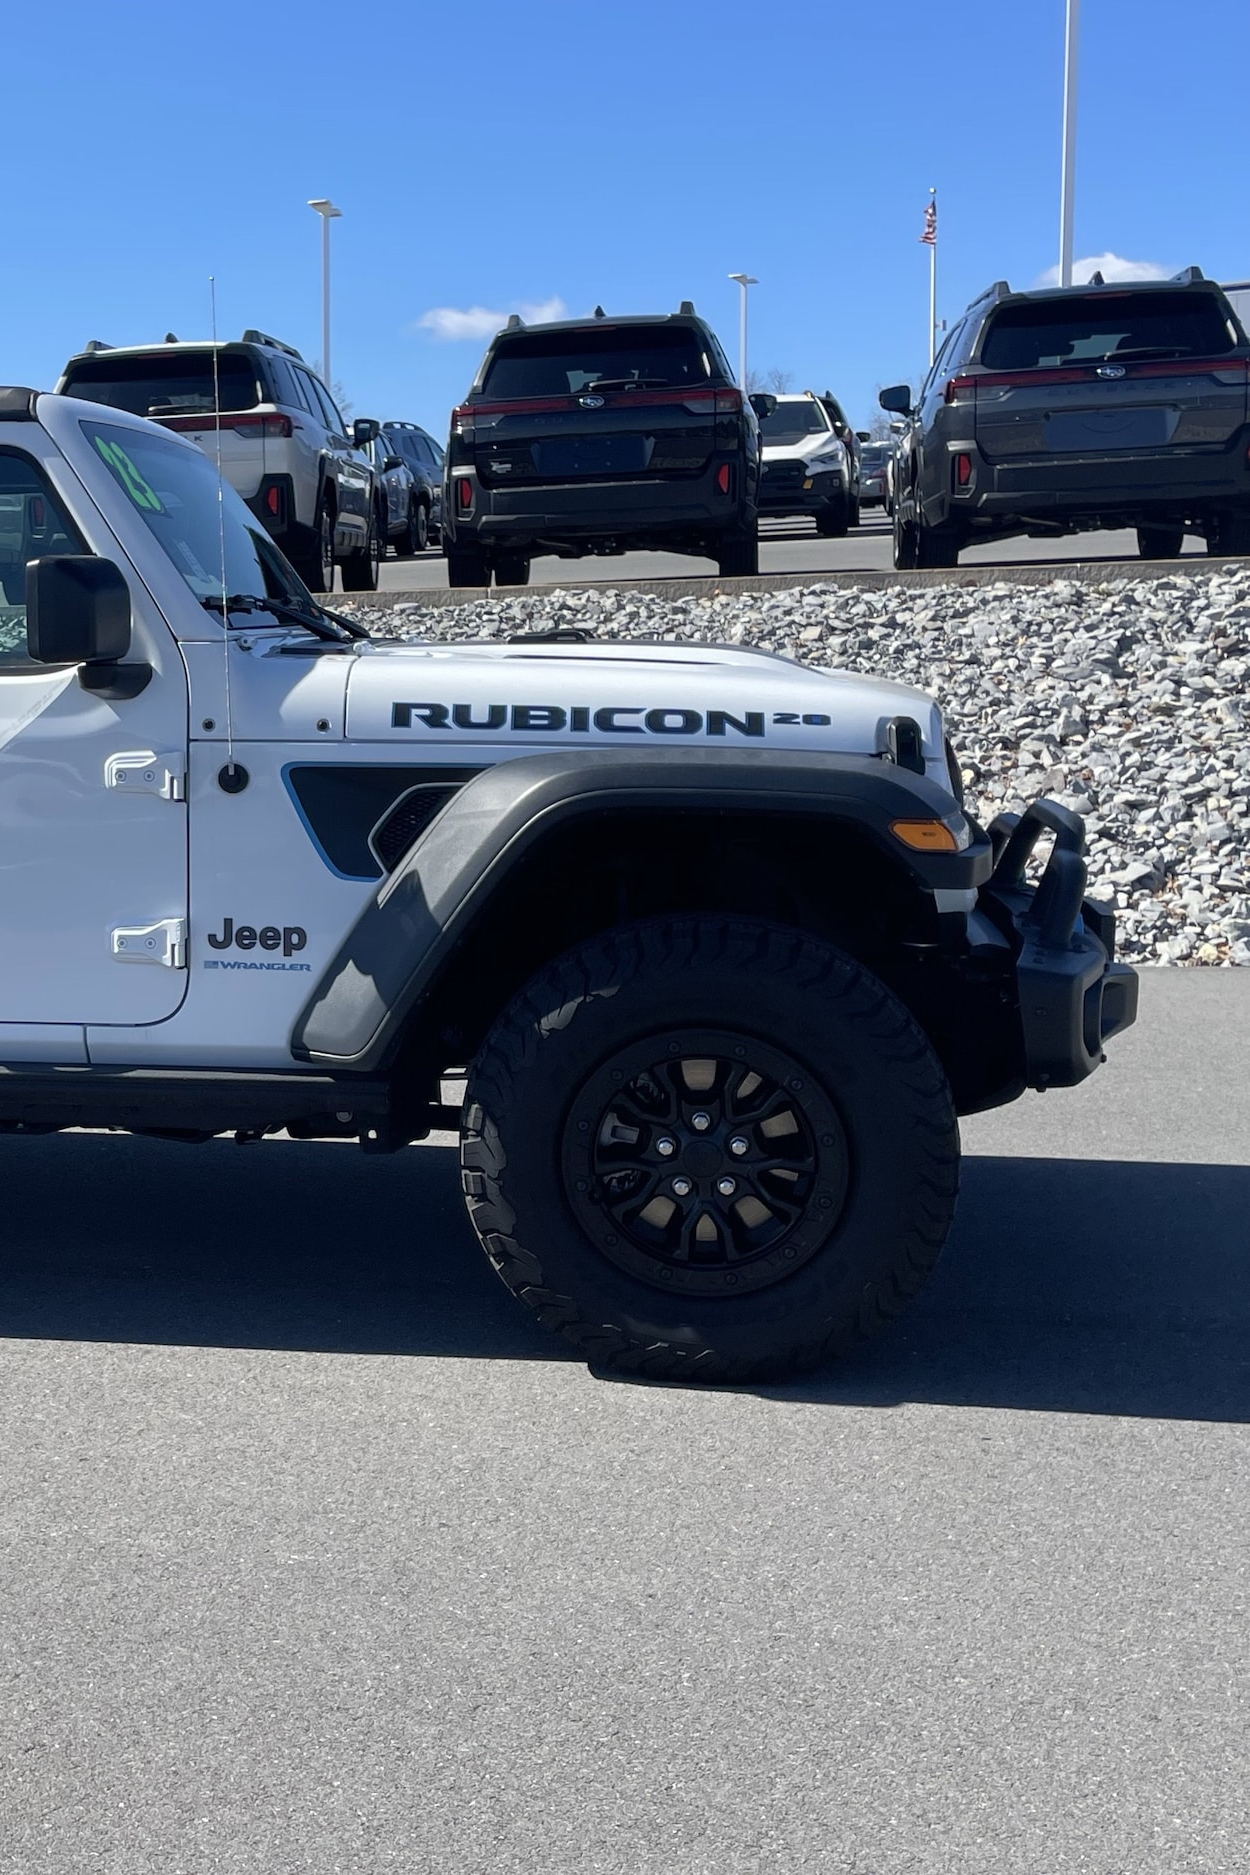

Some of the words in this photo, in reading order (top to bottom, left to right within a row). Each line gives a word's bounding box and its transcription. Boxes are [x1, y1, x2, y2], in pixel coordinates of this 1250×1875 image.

[391, 701, 765, 737] RUBICON
[772, 712, 831, 726] 20
[208, 918, 307, 956] Jeep
[220, 961, 311, 972] WRANGLER
